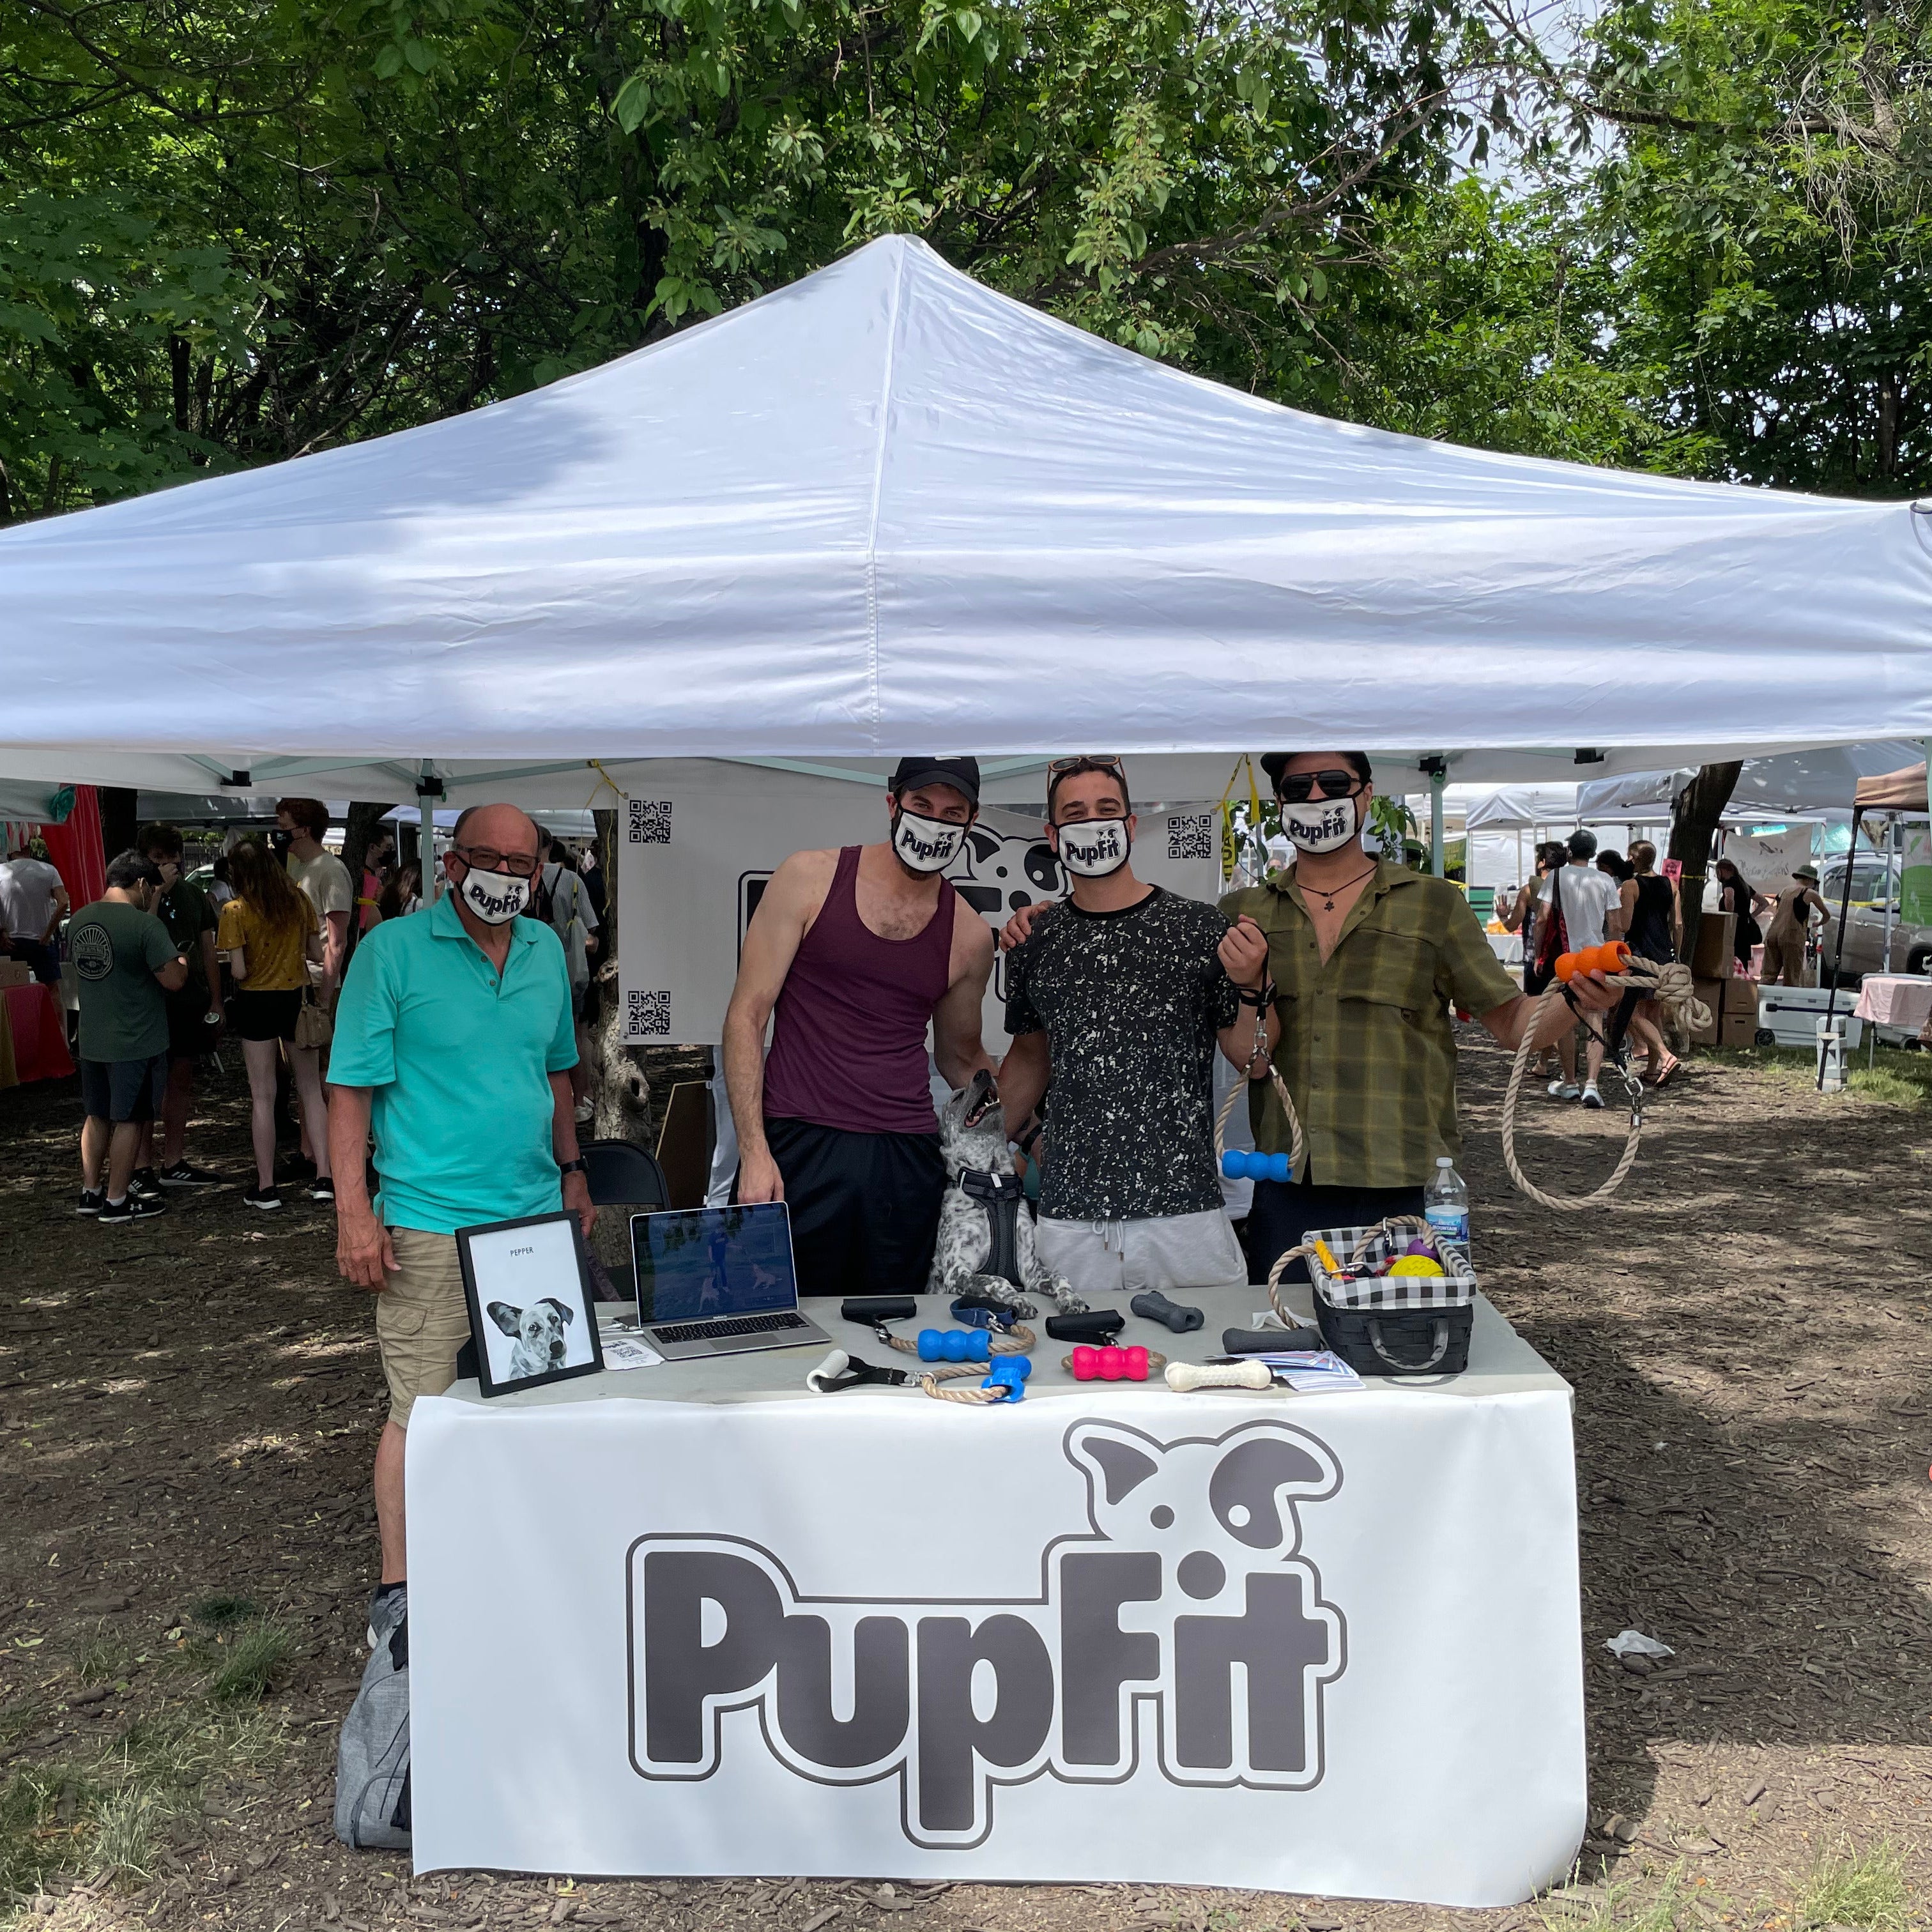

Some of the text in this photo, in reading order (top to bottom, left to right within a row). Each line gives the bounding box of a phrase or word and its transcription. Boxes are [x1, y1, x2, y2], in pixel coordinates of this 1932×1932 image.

[901, 829, 952, 861] PupFit
[1289, 818, 1346, 845] PupFit
[1065, 839, 1119, 866] PupFit
[470, 884, 521, 916] PupFit
[510, 1246, 534, 1257] PEPPER
[644, 1551, 1329, 1832] PupFit
